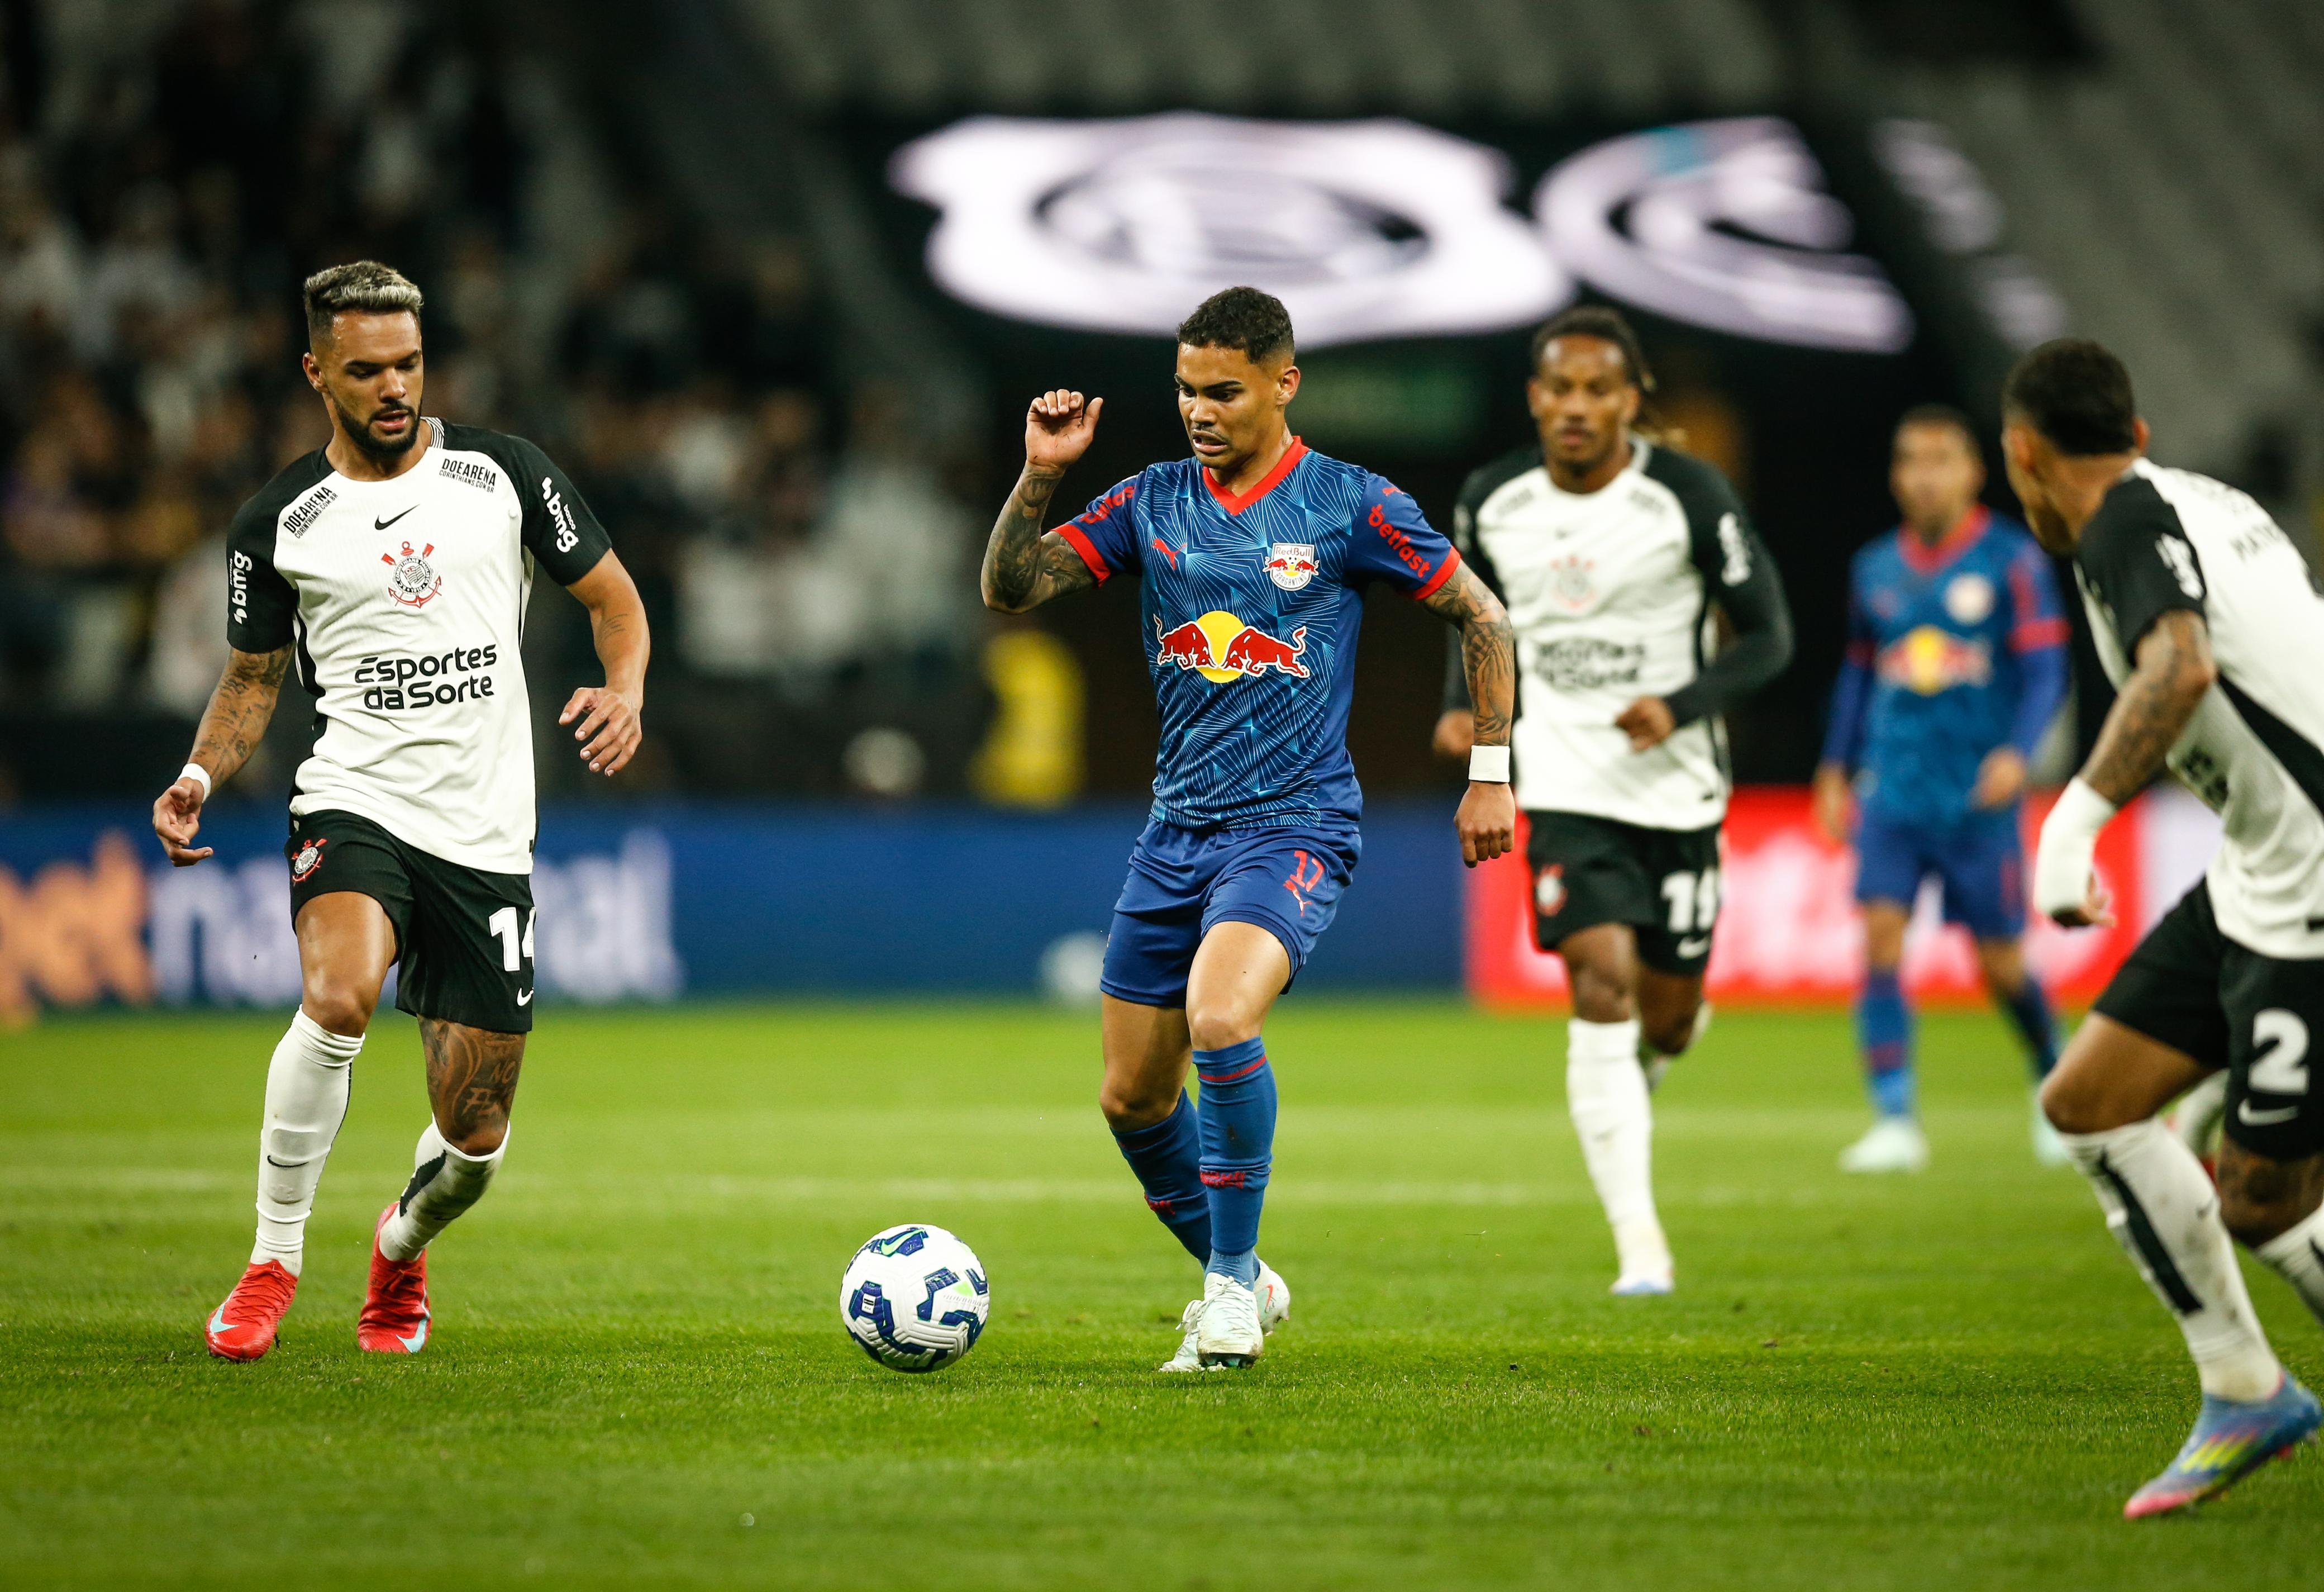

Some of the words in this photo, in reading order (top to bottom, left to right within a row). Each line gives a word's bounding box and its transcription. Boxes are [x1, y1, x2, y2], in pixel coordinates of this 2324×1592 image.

[442, 458, 496, 486] DOEARENA
[283, 487, 332, 534] DOEARENA
[547, 492, 579, 553] bmg
[564, 503, 576, 530] banco
[1368, 504, 1431, 578] betfast
[232, 550, 253, 607] bmg
[355, 644, 497, 687] Esportes
[1290, 850, 1324, 892] 17
[2247, 1008, 2311, 1096] 2
